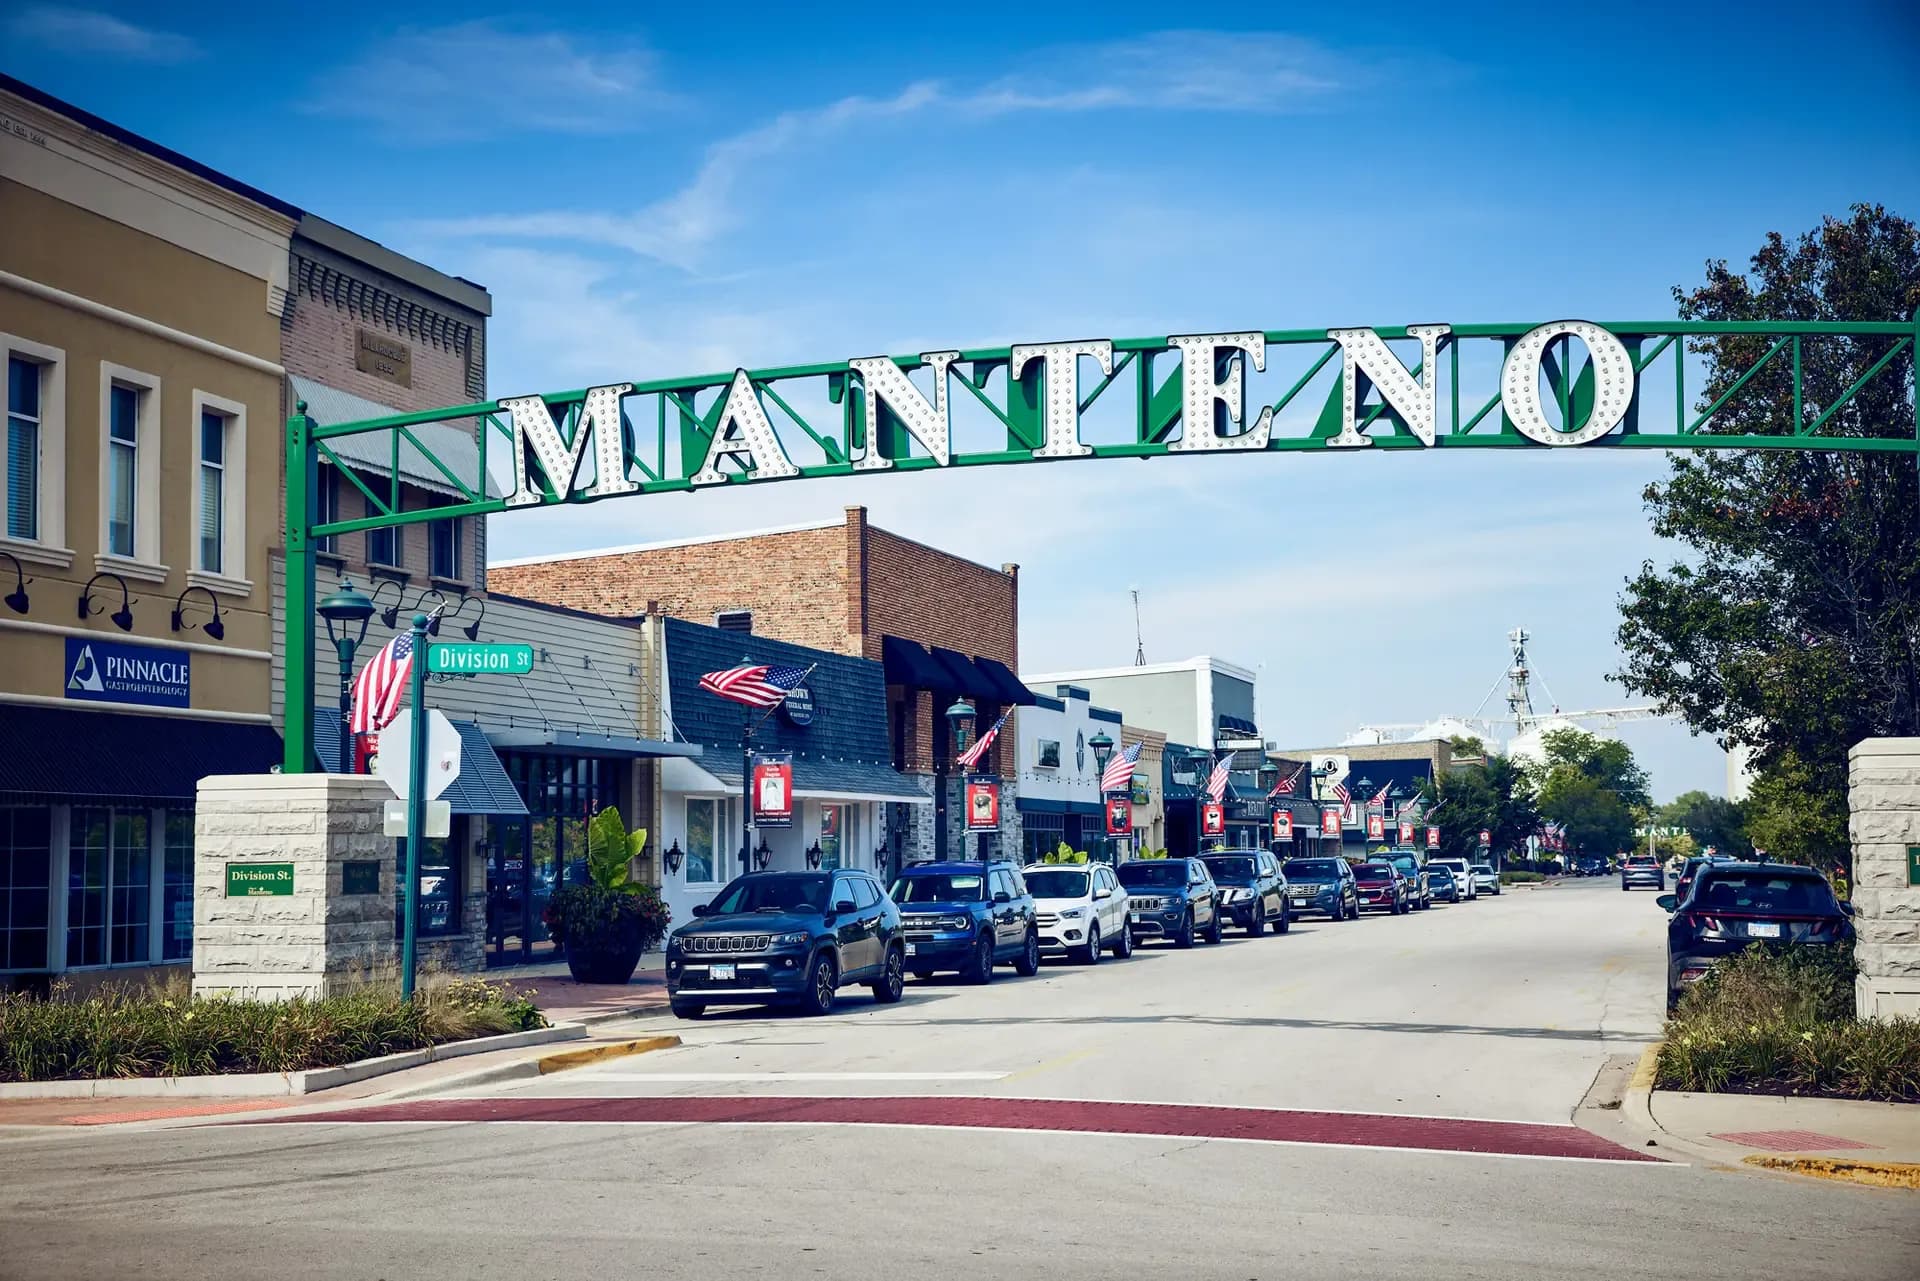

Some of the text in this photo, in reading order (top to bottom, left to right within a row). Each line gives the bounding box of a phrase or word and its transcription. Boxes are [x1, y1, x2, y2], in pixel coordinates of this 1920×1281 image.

[497, 319, 1637, 508] MANTENO
[440, 648, 529, 669] Division St
[106, 656, 188, 685] PINNACLE
[106, 681, 187, 696] GASTROENTEROLOGY
[232, 870, 292, 881] Division St.
